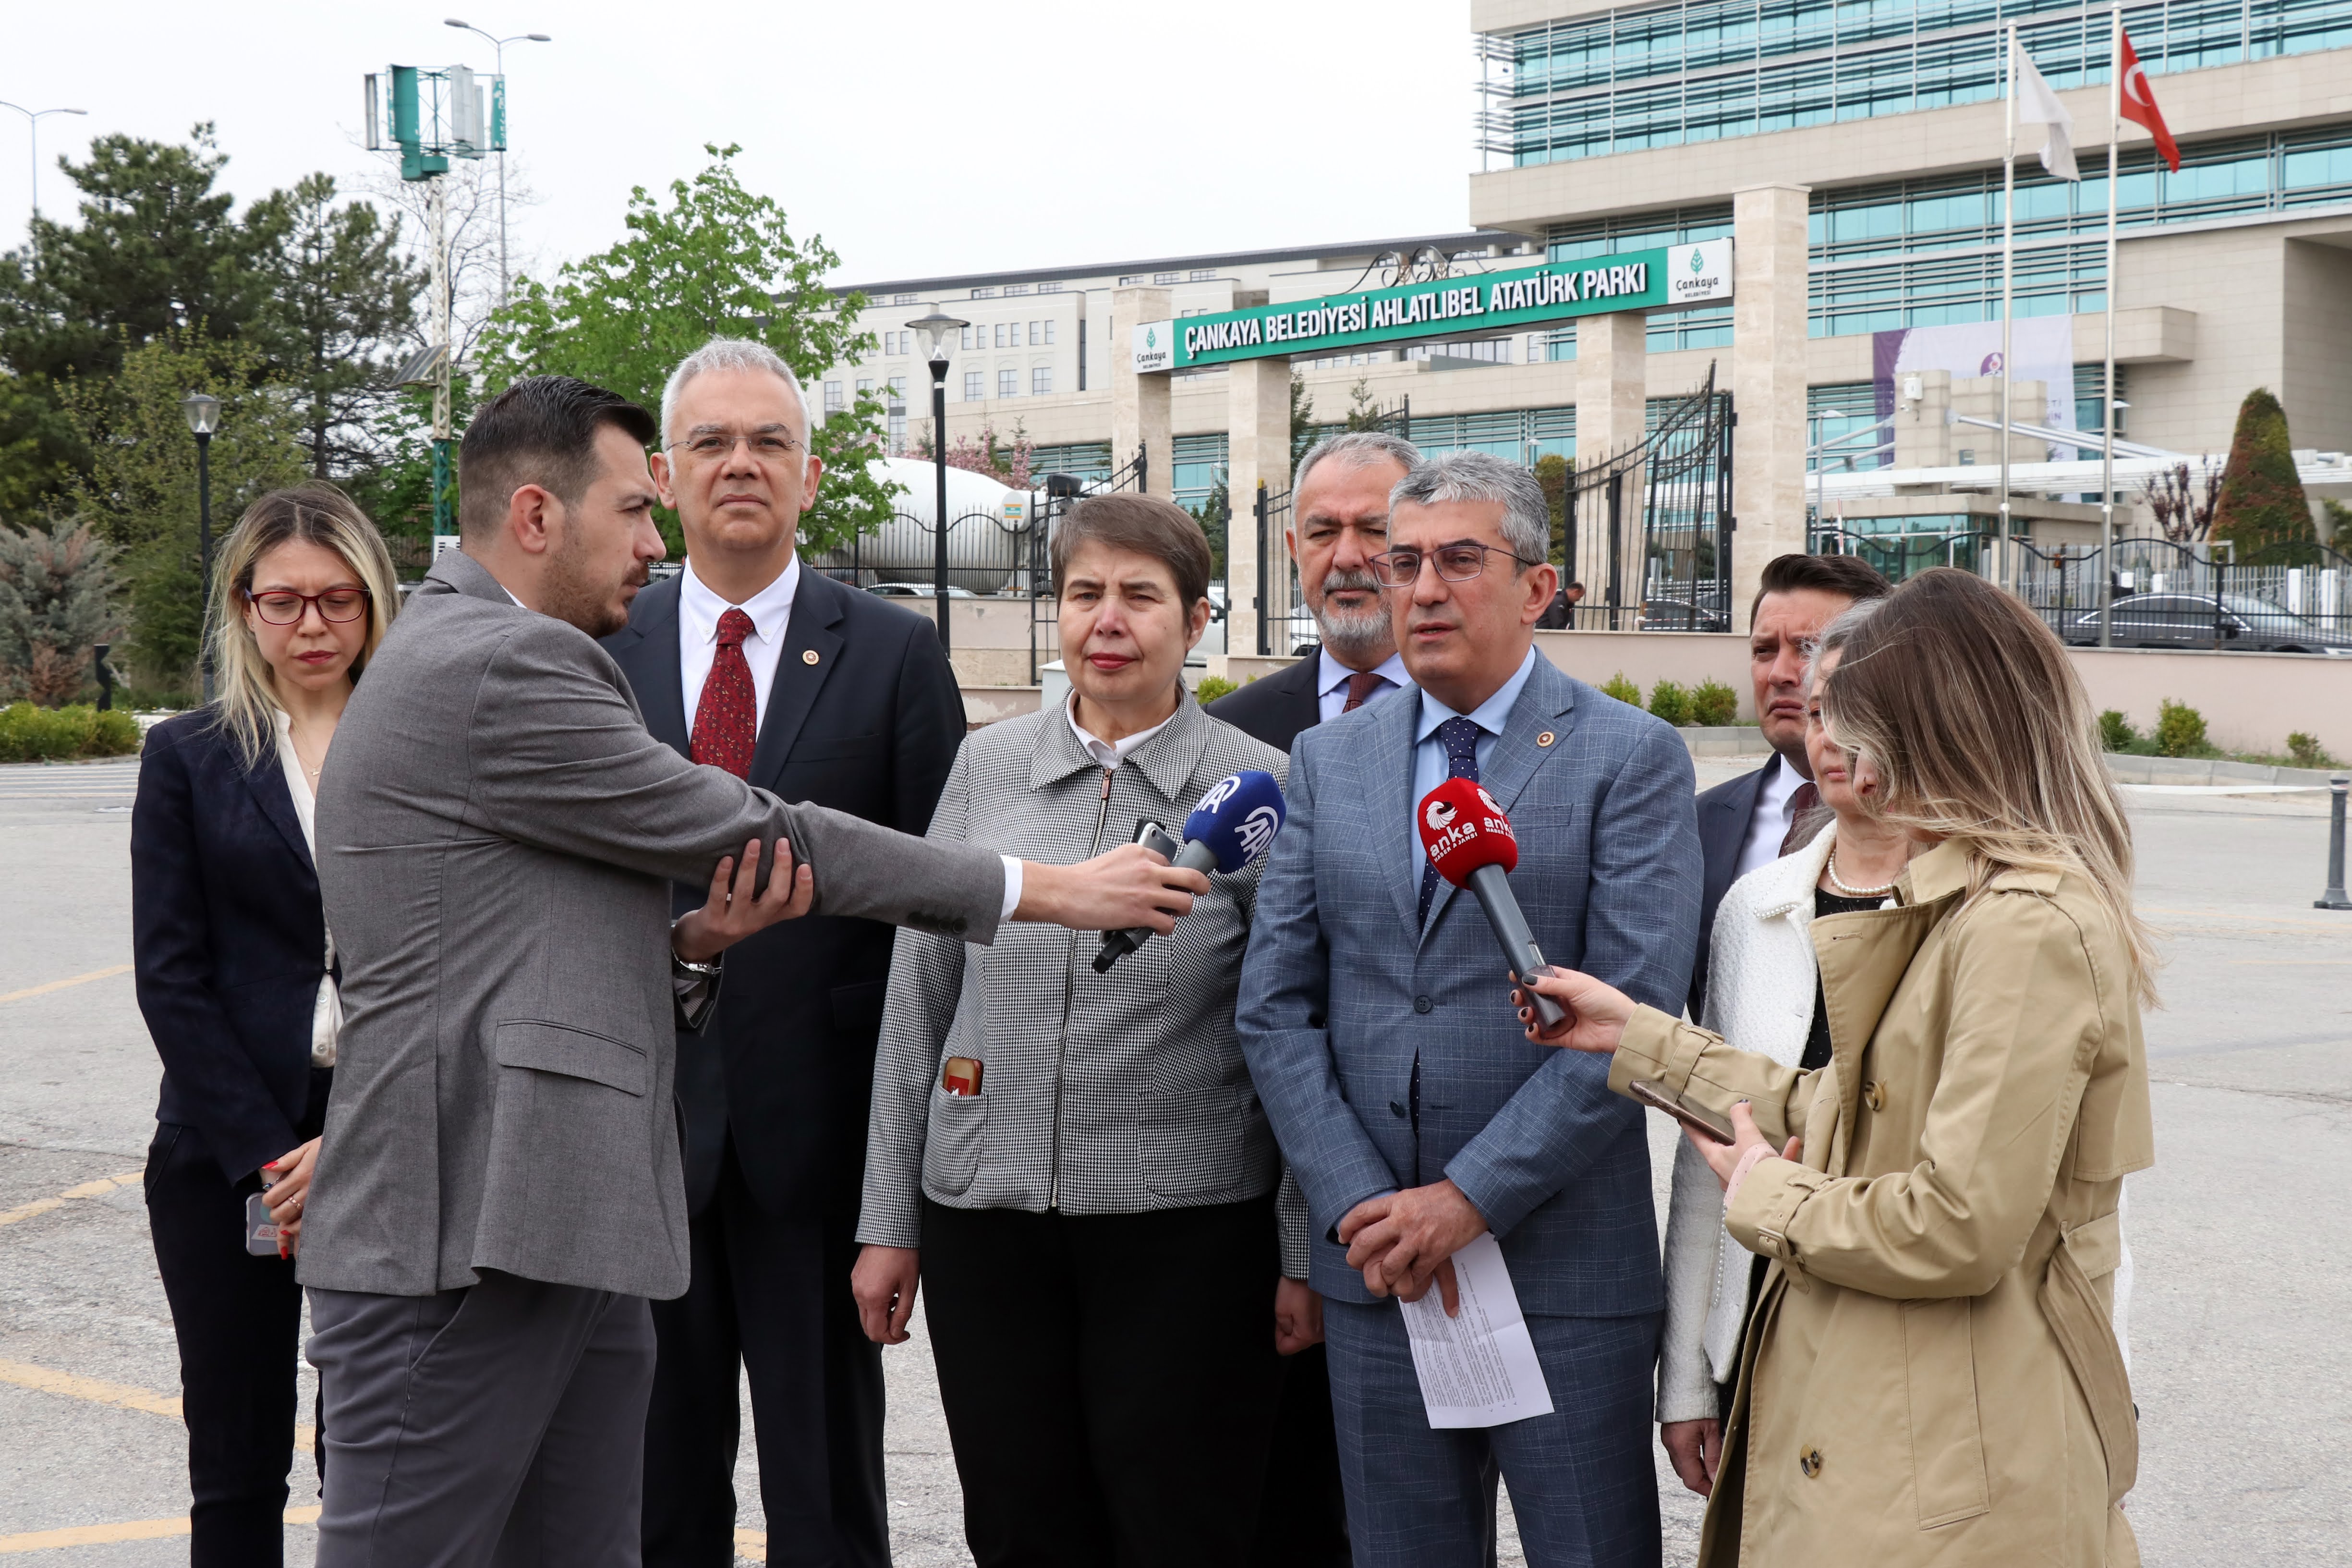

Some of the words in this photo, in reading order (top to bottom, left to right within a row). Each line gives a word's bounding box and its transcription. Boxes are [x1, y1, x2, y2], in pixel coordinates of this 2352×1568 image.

[1676, 277, 1719, 291] Çankaya
[1185, 318, 1261, 359] ÇANKAYA
[1266, 295, 1367, 343] BELEDİYESİ
[1371, 286, 1484, 328] AHLATLIBEL
[1489, 269, 1579, 312] ATATÜRK
[1584, 262, 1646, 299] PARKI
[1137, 352, 1166, 363] Çankaya
[1234, 816, 1272, 864] AA
[1430, 822, 1475, 857] anka
[1434, 846, 1451, 863] HABER
